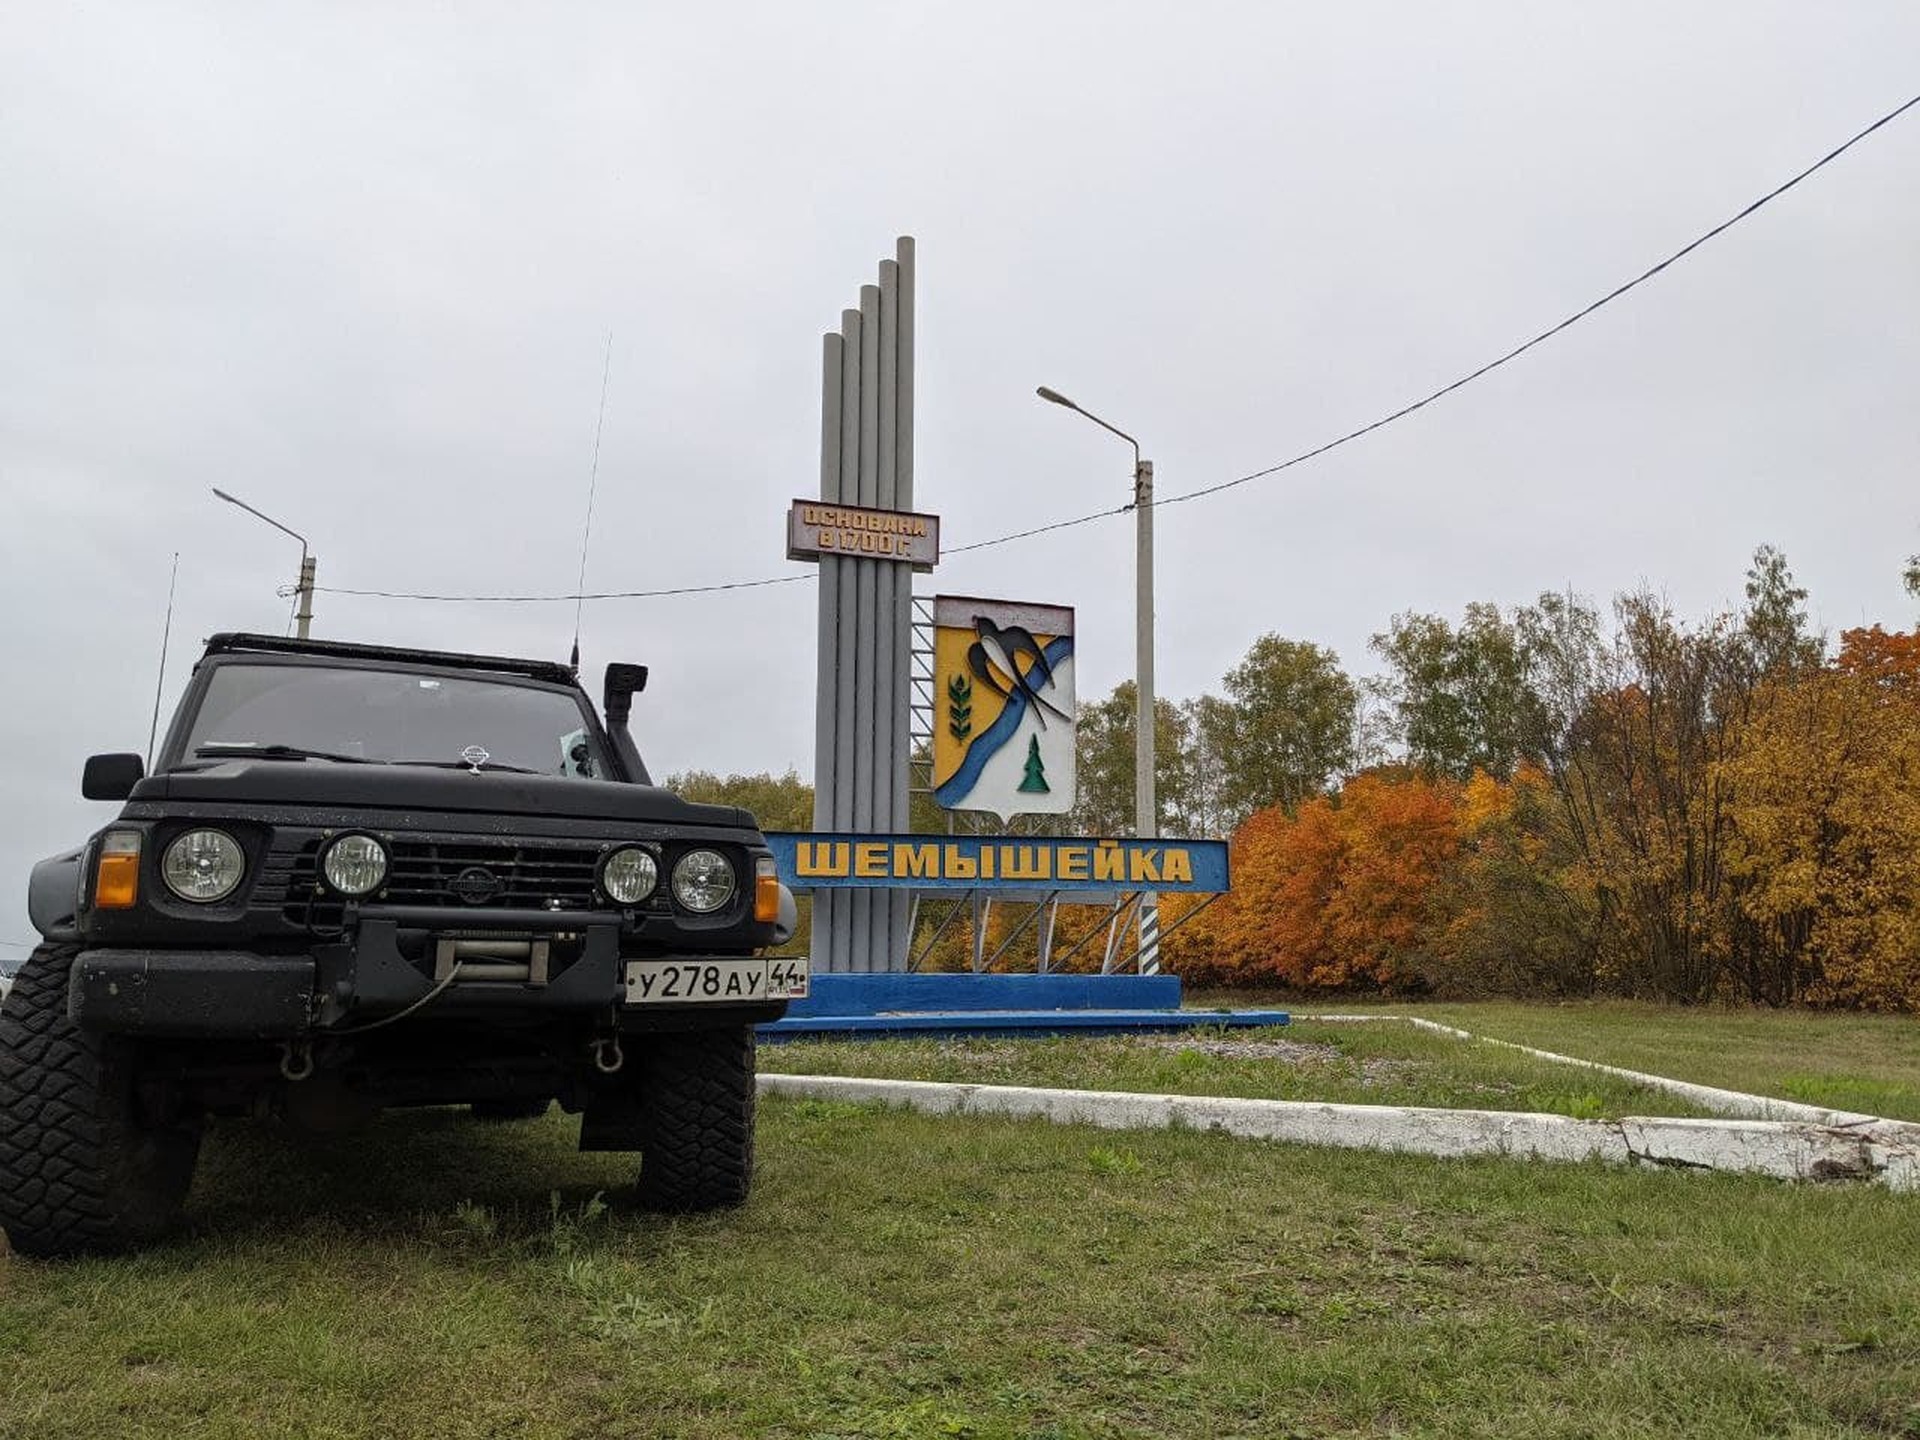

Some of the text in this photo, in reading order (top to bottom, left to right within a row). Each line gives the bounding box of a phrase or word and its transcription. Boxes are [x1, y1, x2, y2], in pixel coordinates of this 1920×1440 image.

[804, 505, 927, 537] ОСНОВАНА
[819, 529, 834, 548] В
[840, 529, 892, 554] 1700
[796, 840, 1193, 882] ШЕМЫШЕЙКА
[770, 963, 798, 986] 44
